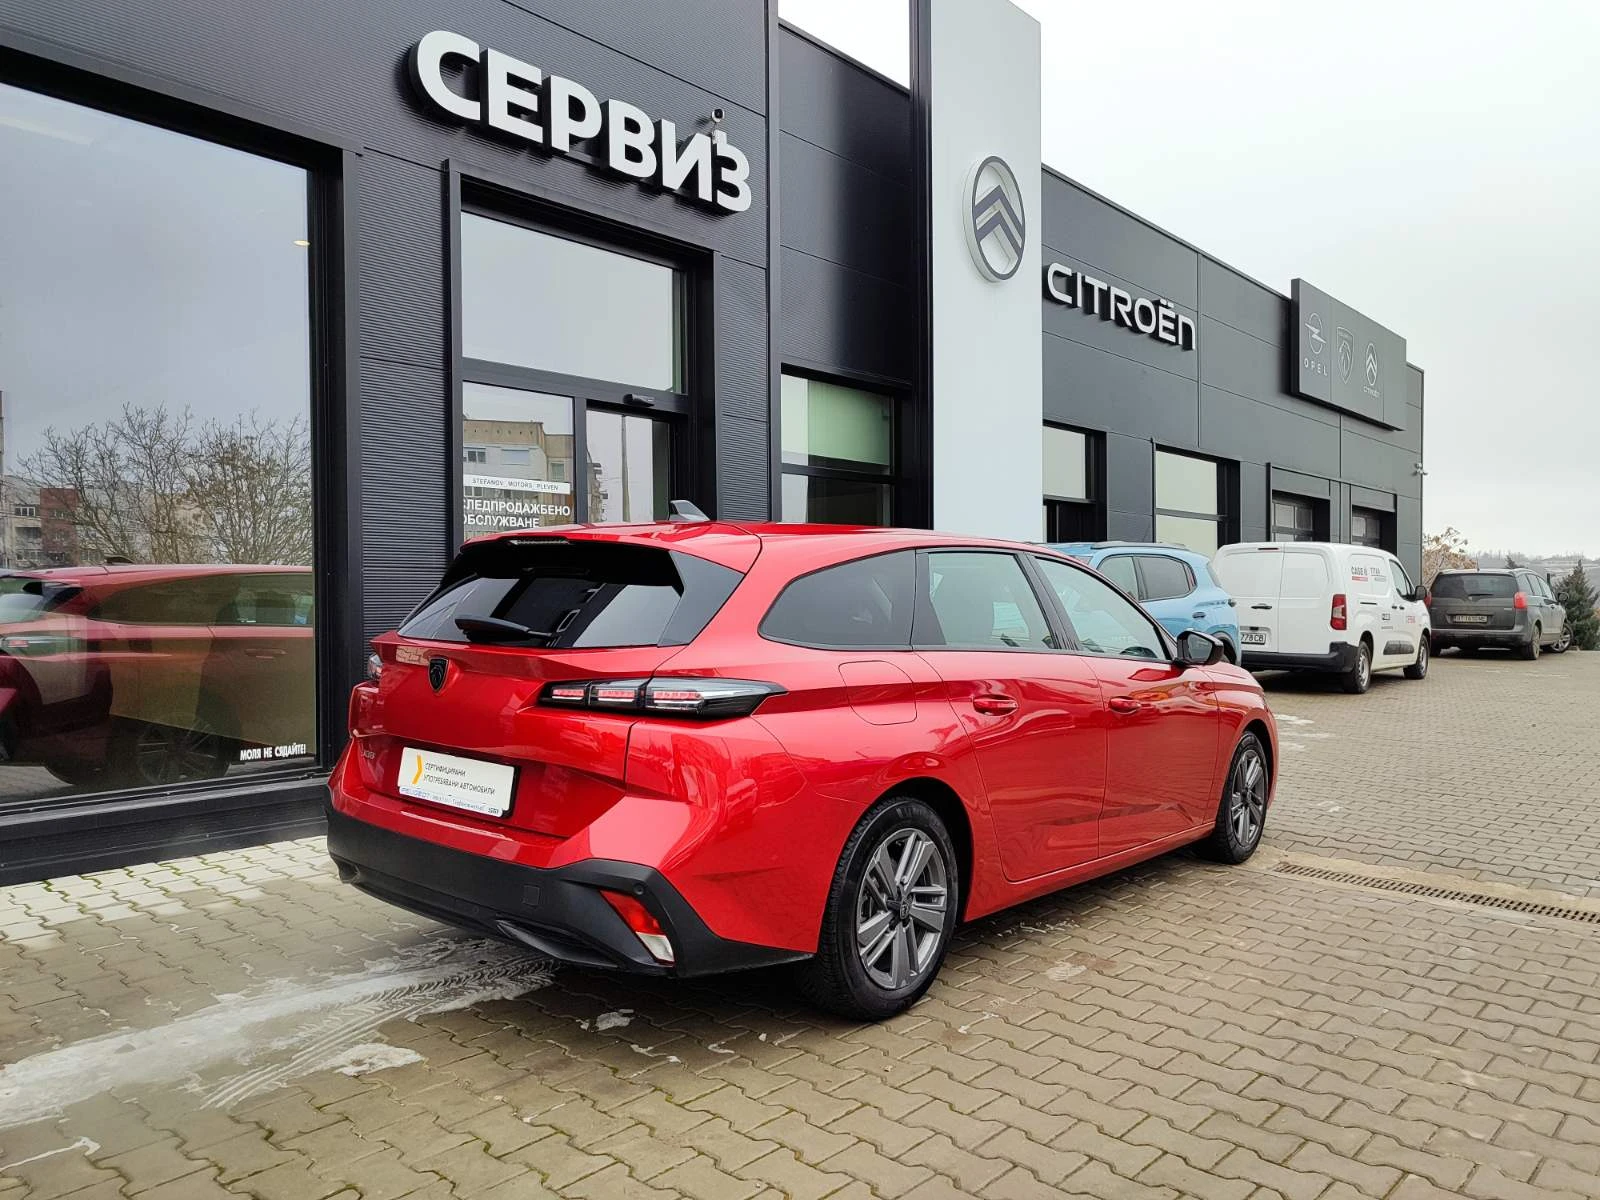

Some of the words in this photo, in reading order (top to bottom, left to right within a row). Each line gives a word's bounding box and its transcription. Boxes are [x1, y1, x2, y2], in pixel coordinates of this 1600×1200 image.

[414, 30, 752, 212] СЕРВИЗ
[1046, 262, 1197, 351] CITROËN
[1303, 357, 1328, 377] OPEL
[472, 478, 503, 486] STEFANOV
[537, 483, 559, 491] PLEVEN
[463, 498, 571, 516] ЛЕДПРОДАЖБЕНО
[240, 748, 262, 761] МОЛЯ
[263, 747, 273, 759] НЕ
[459, 782, 496, 795] АВТОМОБИЛИ
